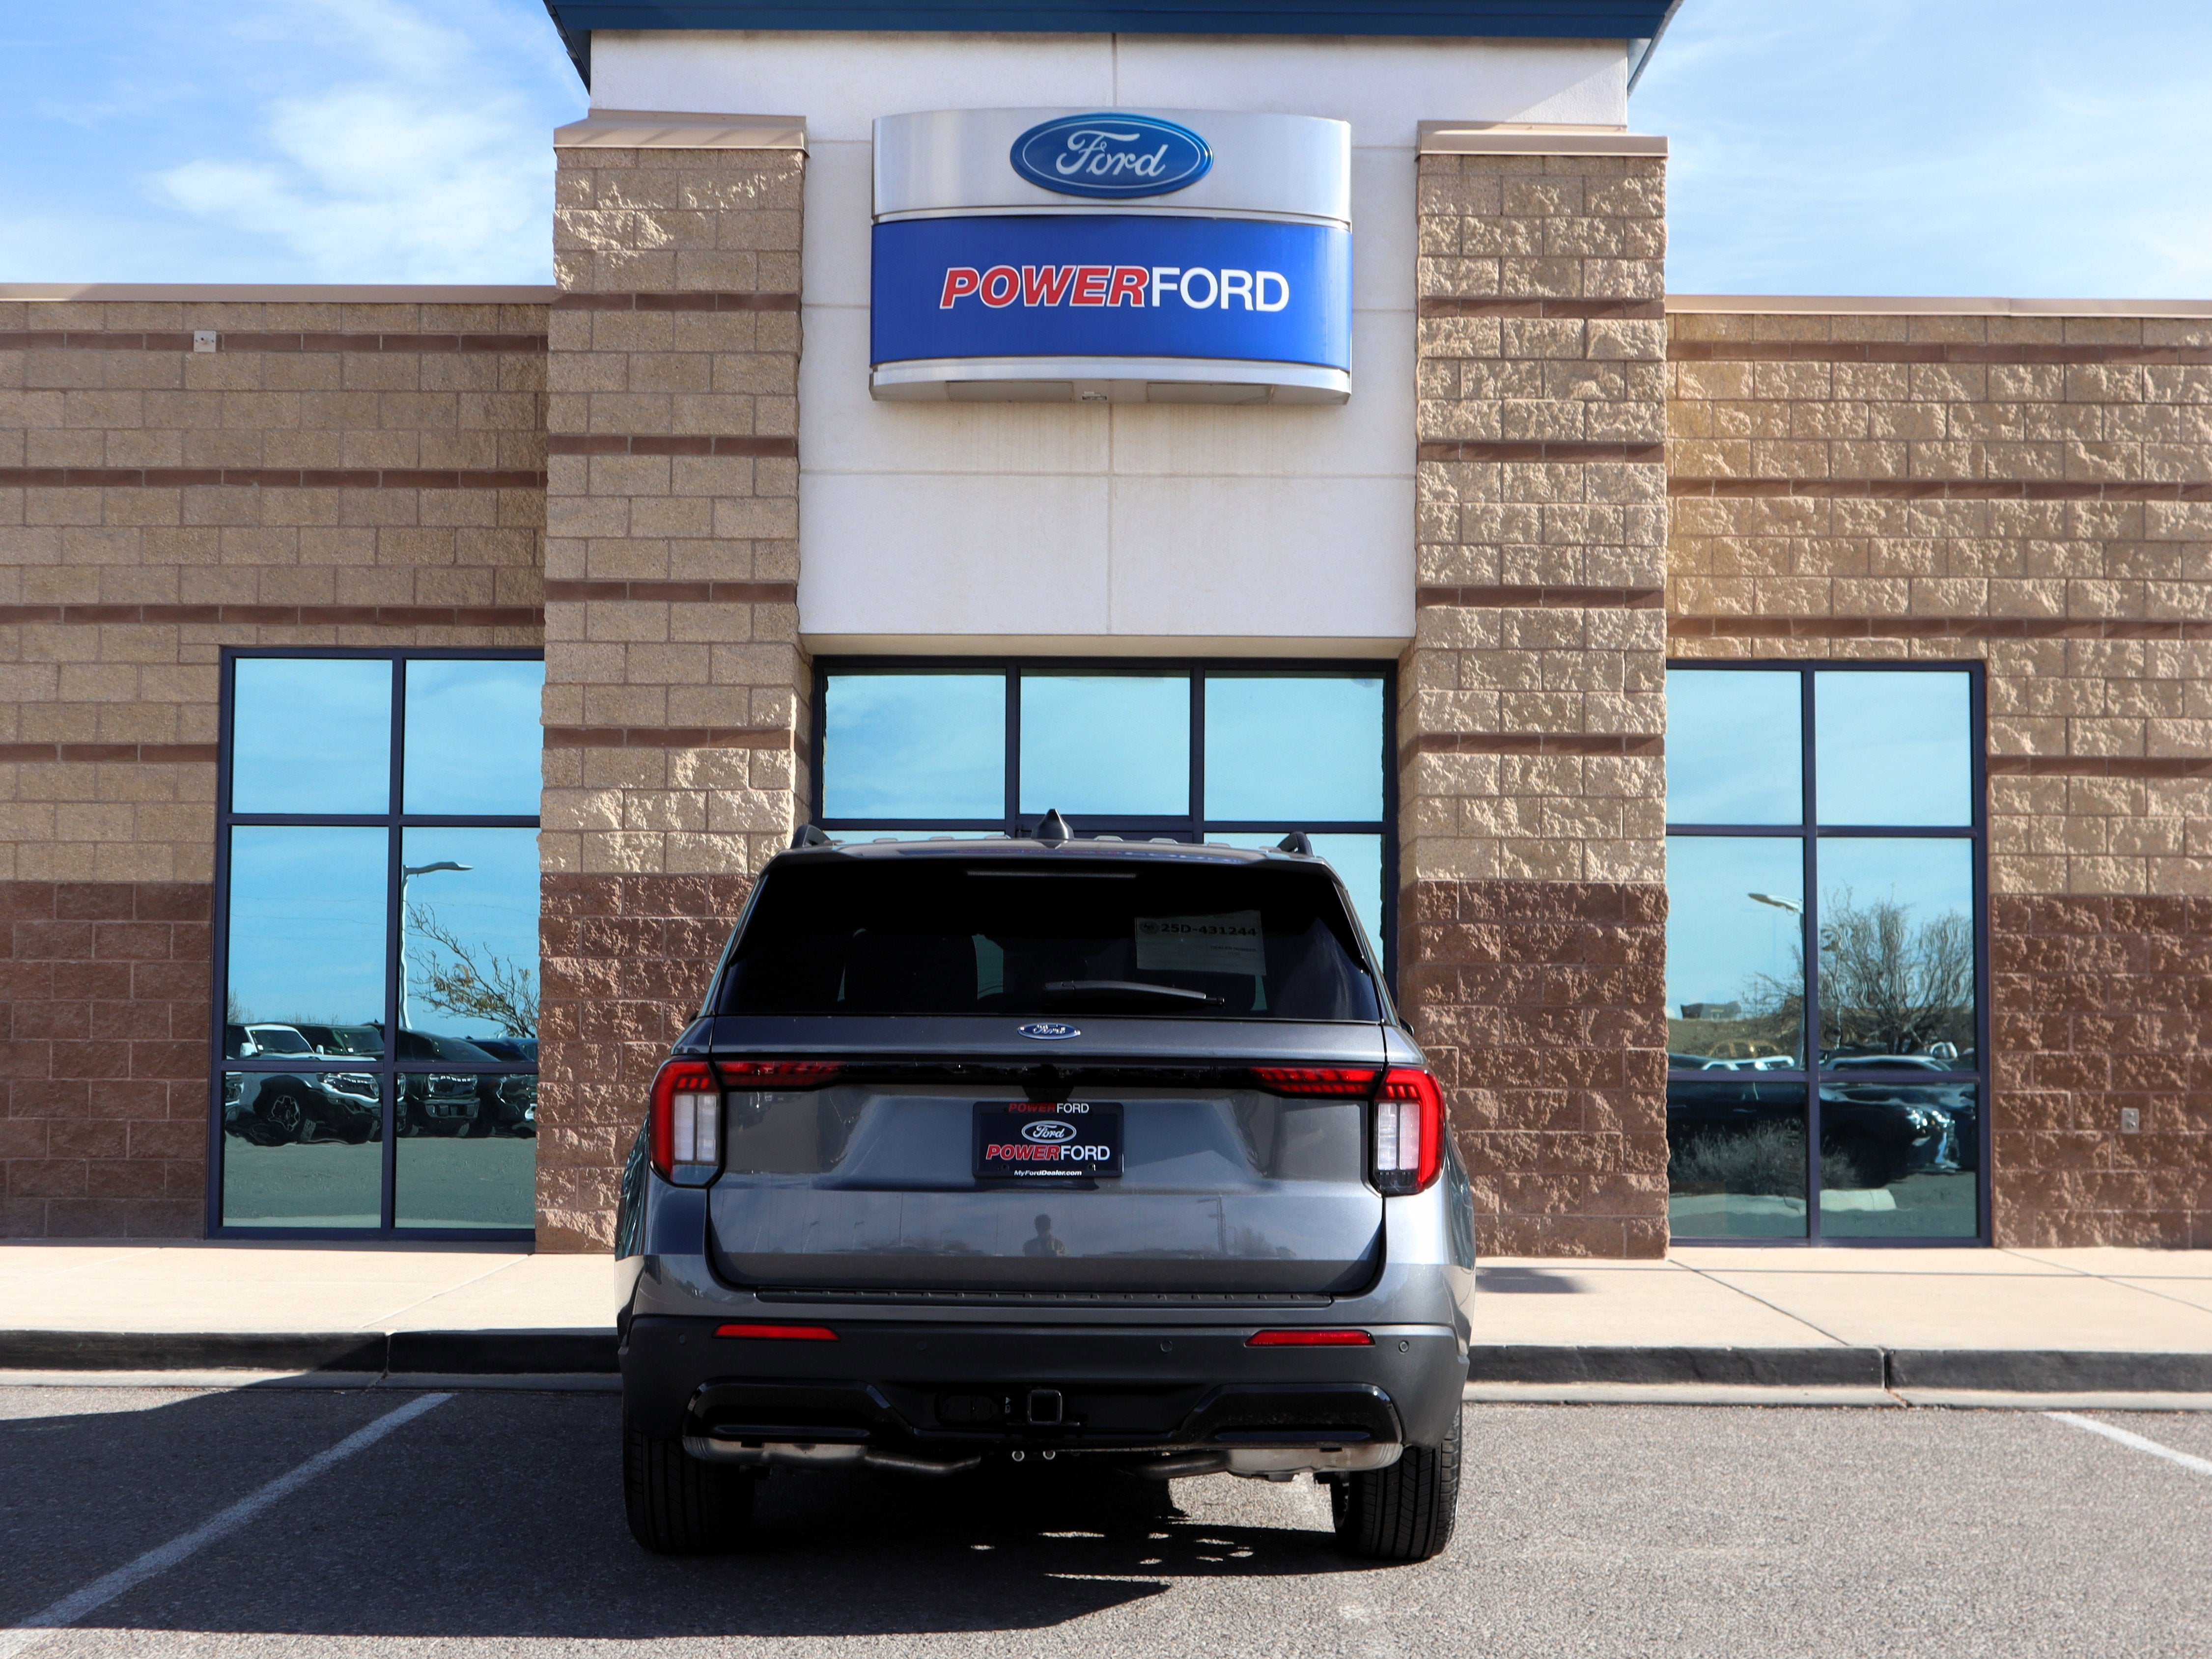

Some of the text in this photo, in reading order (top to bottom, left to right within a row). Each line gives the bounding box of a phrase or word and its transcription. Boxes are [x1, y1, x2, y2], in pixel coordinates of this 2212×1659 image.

[1056, 130, 1168, 177] Ford
[939, 265, 1289, 312] POWERFORD
[1161, 924, 1256, 936] 25D-431244
[1033, 1024, 1065, 1034] Ford
[1008, 1103, 1089, 1113] POWERFORD
[1033, 1125, 1064, 1138] Ford
[986, 1144, 1110, 1161] POWERFORD
